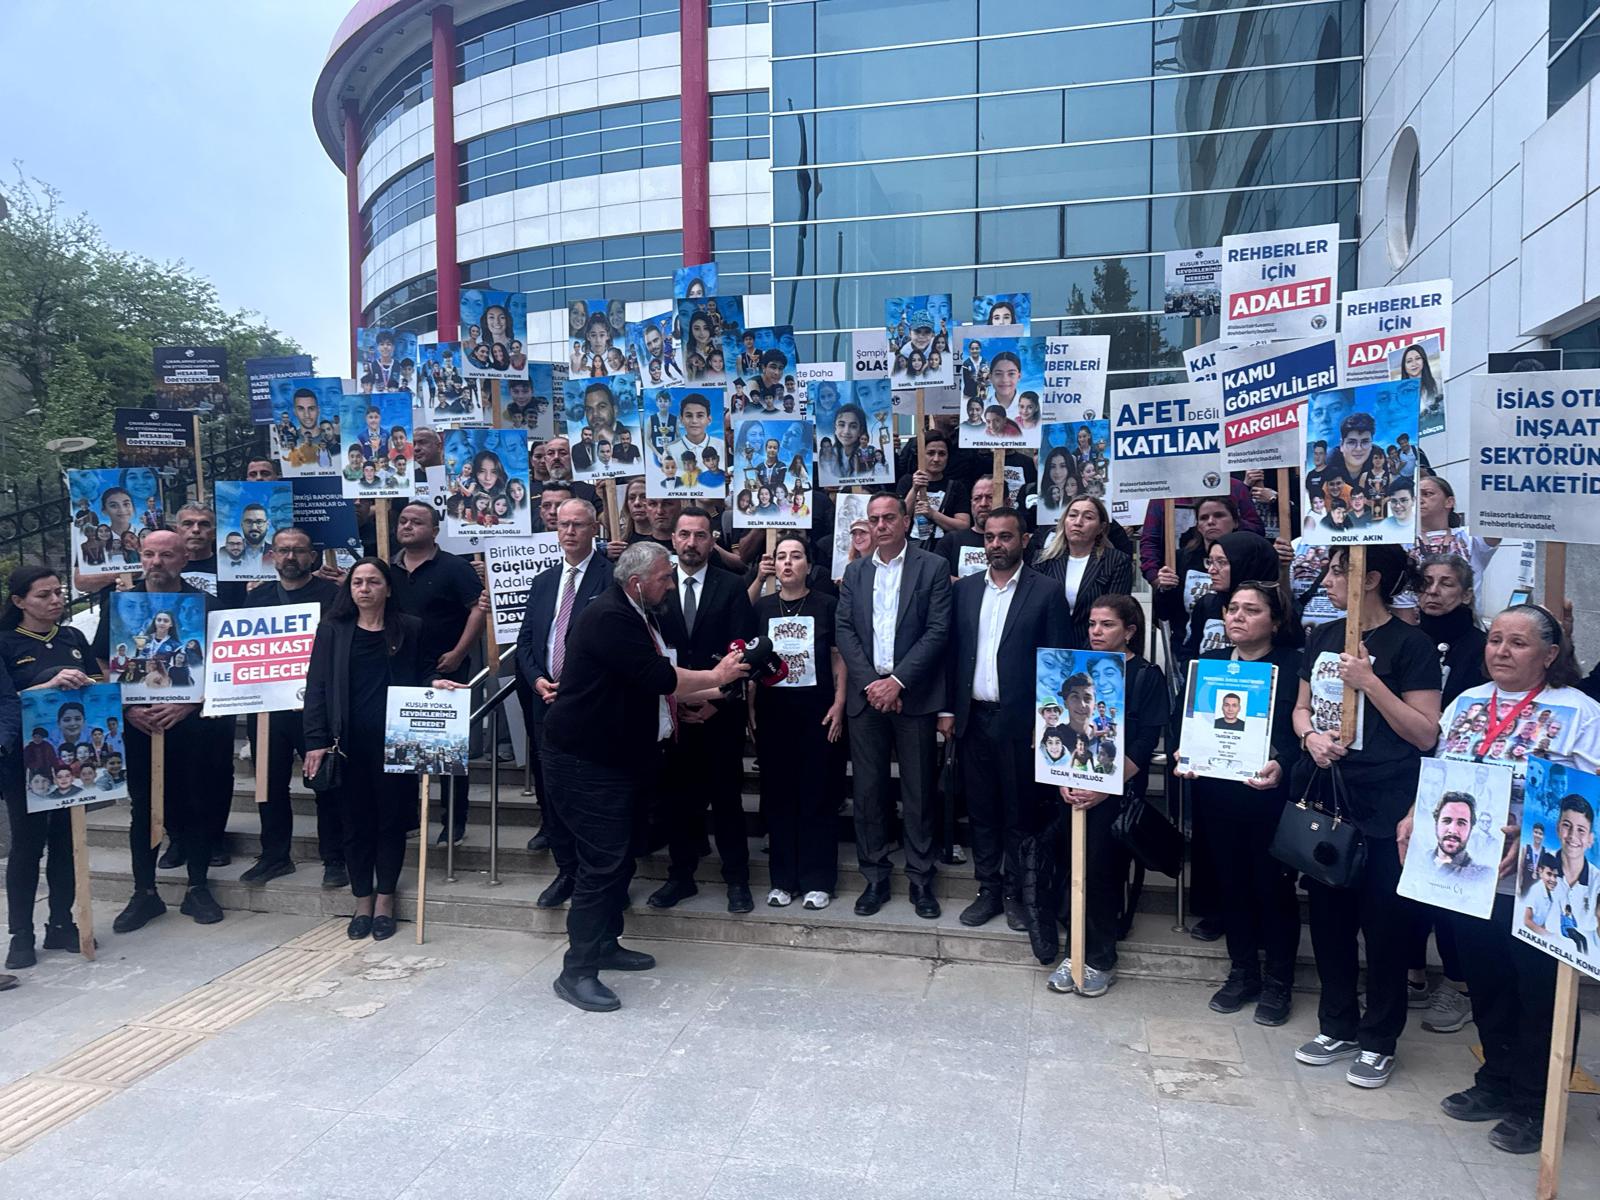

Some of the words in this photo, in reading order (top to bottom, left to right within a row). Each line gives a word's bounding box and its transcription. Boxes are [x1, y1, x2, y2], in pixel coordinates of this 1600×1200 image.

[1229, 240, 1328, 262] REHBERLER
[1262, 263, 1296, 281] İÇİN
[1232, 283, 1326, 317] ADALET
[1348, 293, 1442, 316] REHBERLER
[1379, 316, 1412, 332] İÇİN
[1224, 362, 1275, 390] KAMU
[1226, 366, 1335, 411] GÖREVLİLERİ
[1497, 388, 1554, 409] İSİAS
[1117, 399, 1190, 426] AFET
[1228, 408, 1299, 439] YARGILA
[1516, 416, 1600, 438] İNŞAAT
[1117, 429, 1220, 456] KATLİAM
[490, 546, 534, 558] Birlikte
[496, 593, 529, 606] Müc
[218, 614, 312, 638] ADALET
[215, 643, 265, 661] OLASI
[270, 639, 312, 656] KAST
[214, 672, 230, 683] İLE
[237, 662, 310, 680] GELECEK
[1518, 929, 1547, 948] ATAKAN
[1549, 944, 1573, 962] CELAL
[1576, 958, 1600, 975] KONU
